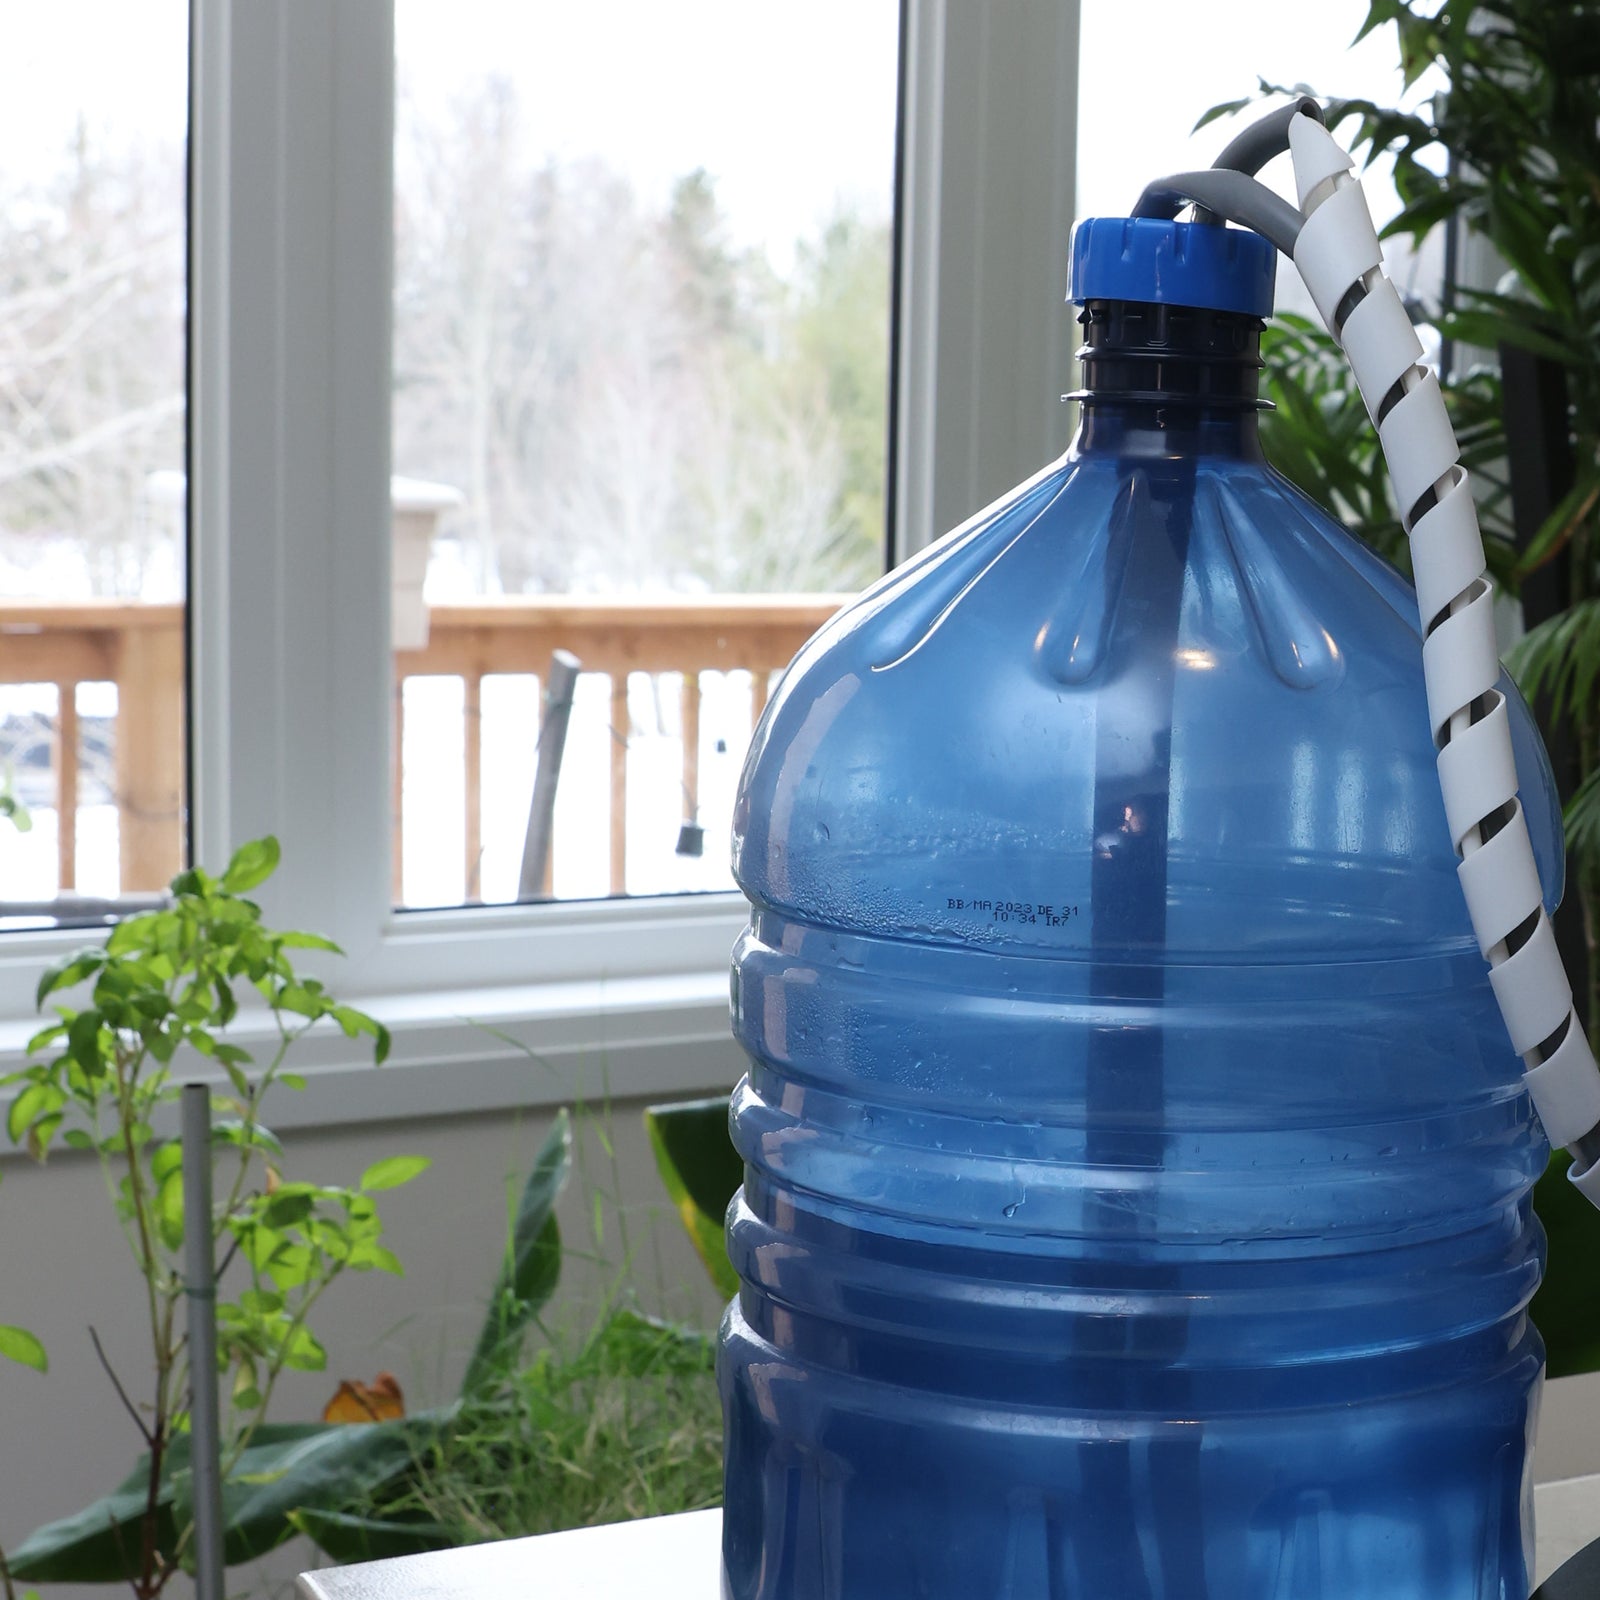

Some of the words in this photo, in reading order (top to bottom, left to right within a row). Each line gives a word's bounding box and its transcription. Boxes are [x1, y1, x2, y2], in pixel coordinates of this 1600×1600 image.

[947, 898, 992, 911] BB/MA
[995, 901, 1032, 914] 2023
[1037, 904, 1054, 916] DE
[1062, 906, 1078, 916] 31
[993, 911, 1036, 925] 10:34
